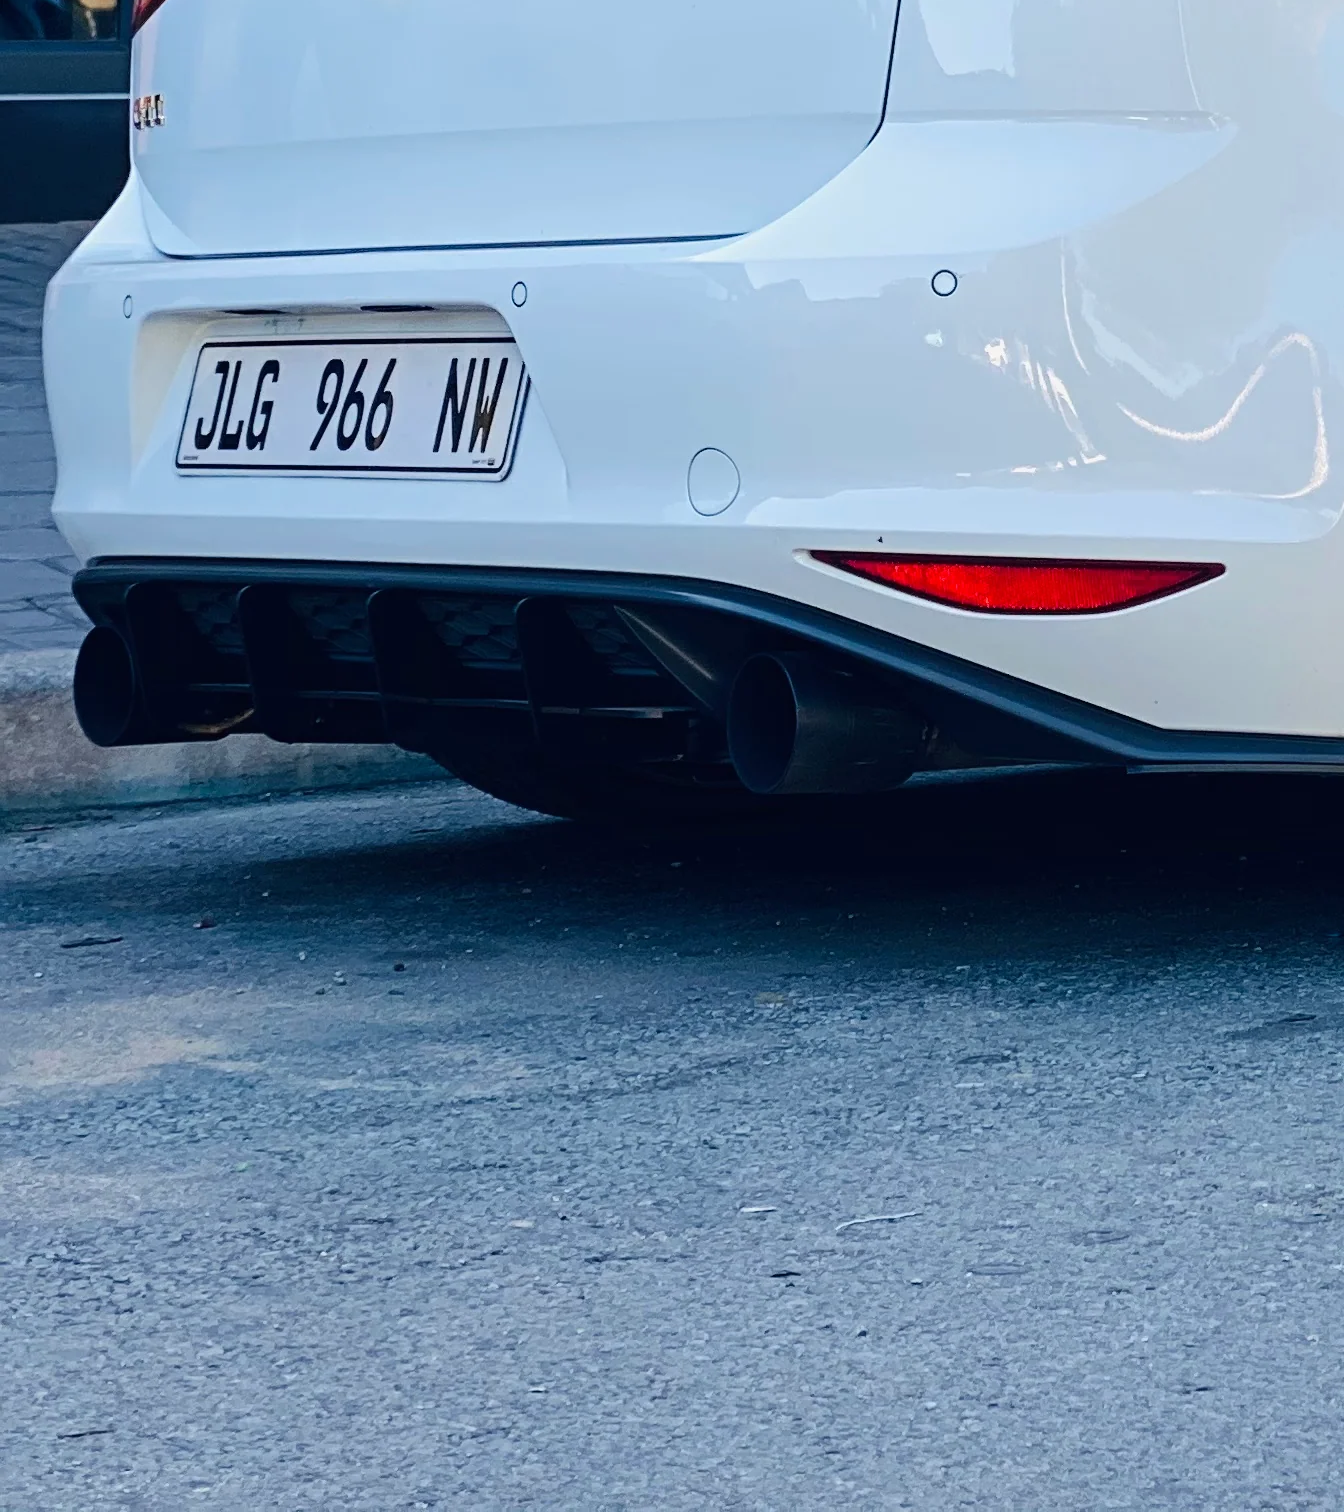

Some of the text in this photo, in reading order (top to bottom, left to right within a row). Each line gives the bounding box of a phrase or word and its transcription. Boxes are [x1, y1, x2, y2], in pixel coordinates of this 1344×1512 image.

[194, 356, 510, 454] JLG 966 NW
